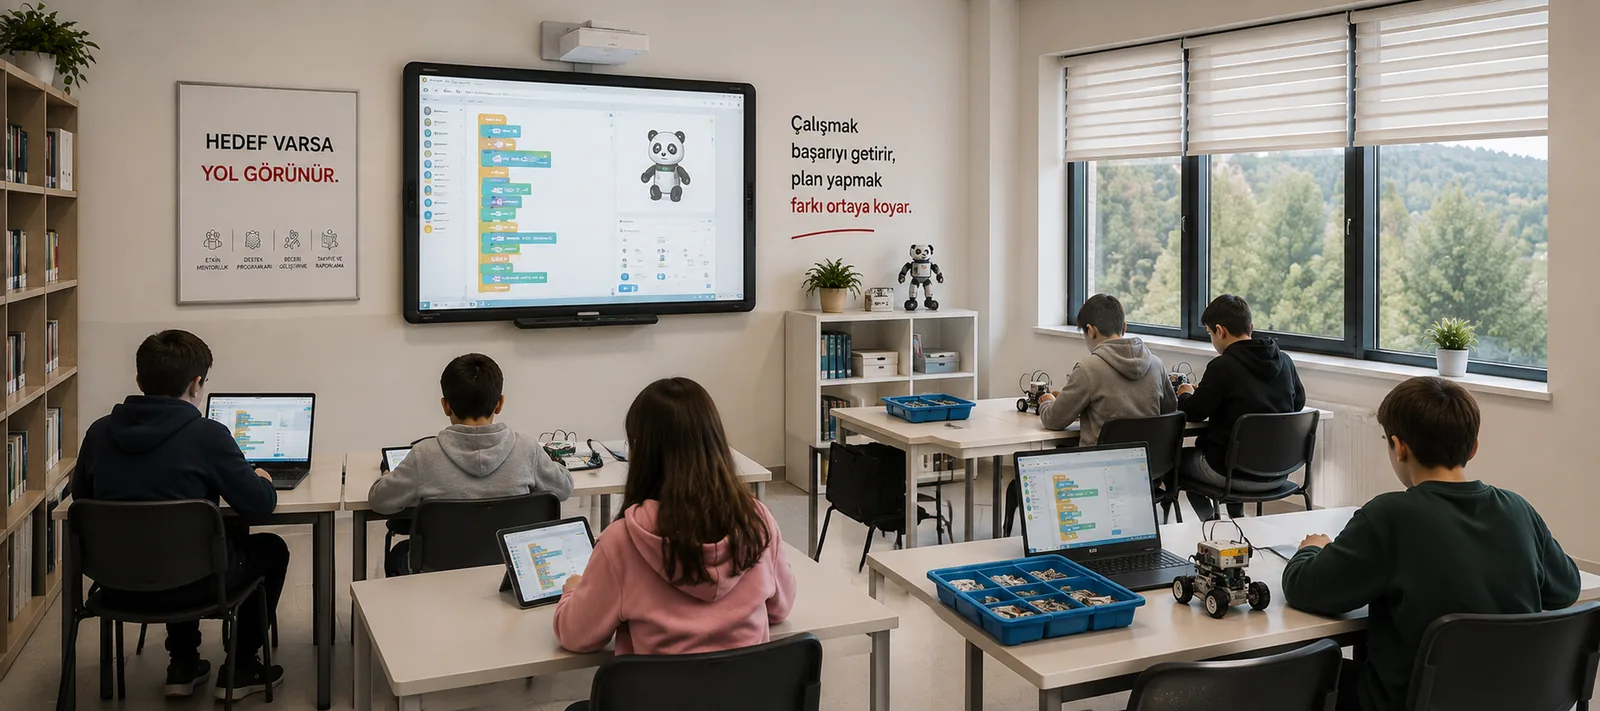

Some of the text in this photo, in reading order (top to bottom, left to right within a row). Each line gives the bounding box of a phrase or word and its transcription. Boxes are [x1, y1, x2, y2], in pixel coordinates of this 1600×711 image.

[791, 115, 858, 136] Çalışmak
[207, 133, 333, 152] HEDEF VARSA
[792, 143, 895, 164] başarıyı getirir,
[201, 163, 338, 182] YOL GÖRÜNÜR.
[792, 170, 882, 190] plan yapmak
[791, 197, 911, 217] farkı ortaya koyar.
